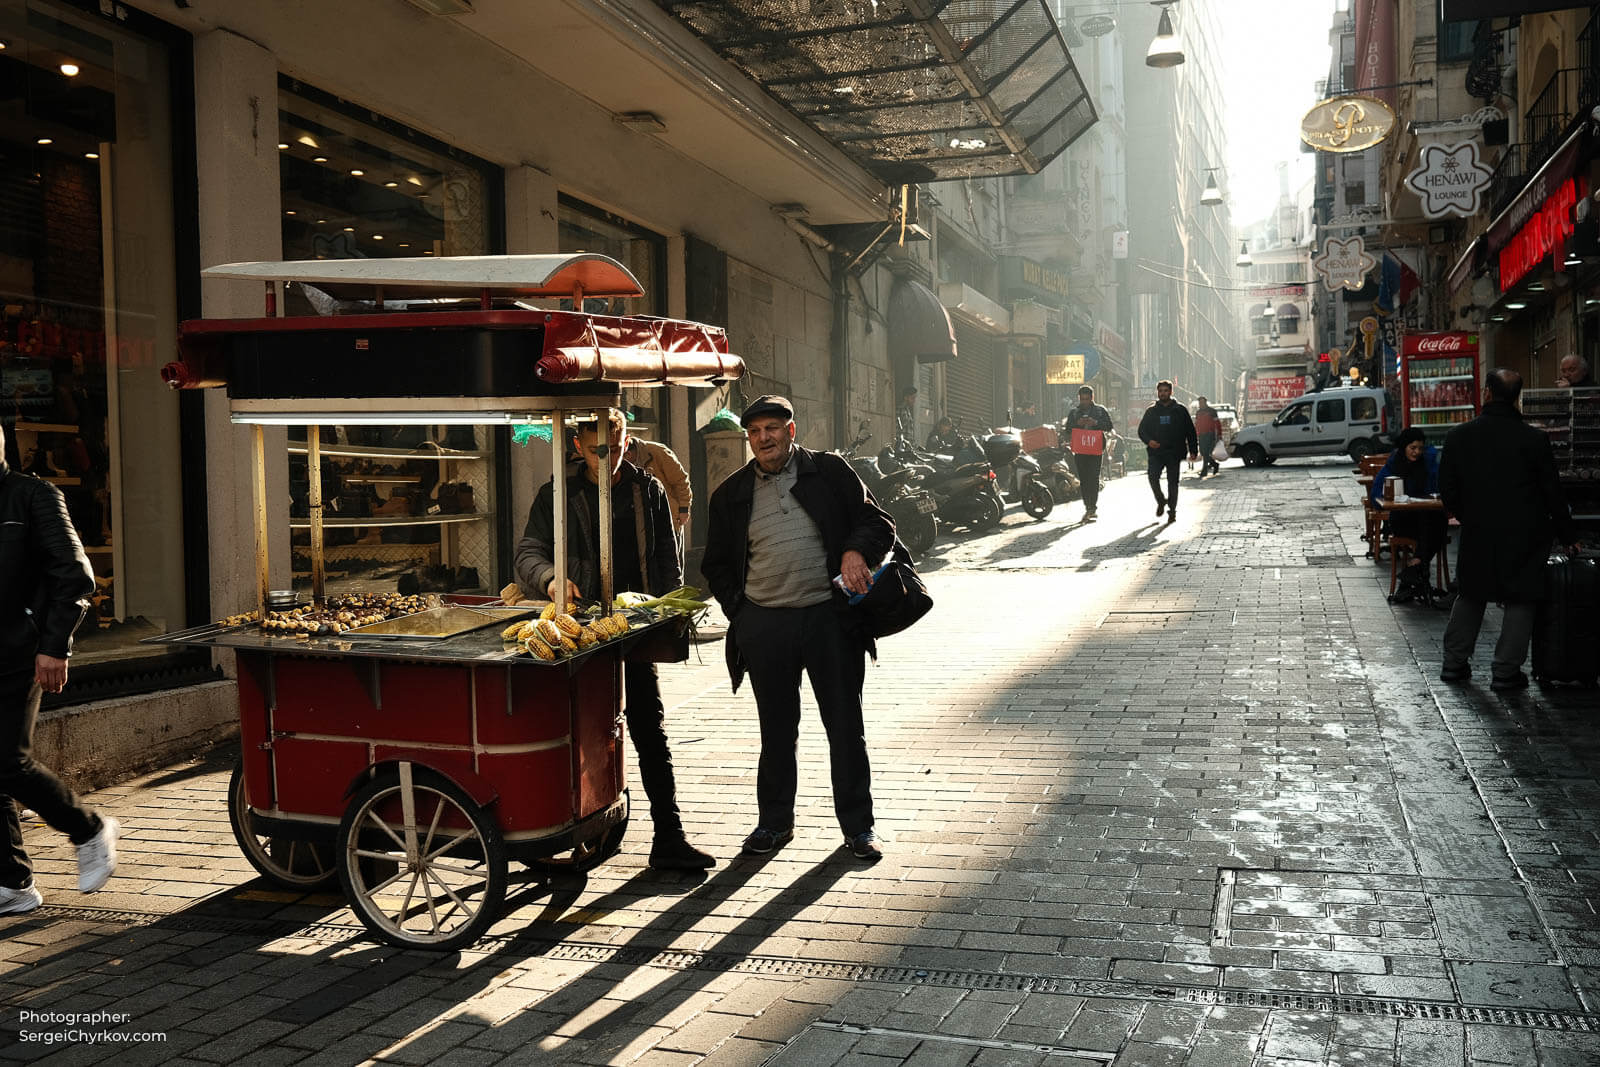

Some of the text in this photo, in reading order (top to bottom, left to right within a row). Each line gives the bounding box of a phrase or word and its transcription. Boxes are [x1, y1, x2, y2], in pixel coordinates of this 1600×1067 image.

[1425, 172, 1477, 187] HENAWI
[1435, 191, 1468, 200] LOUNGE
[1081, 434, 1097, 447] GAP
